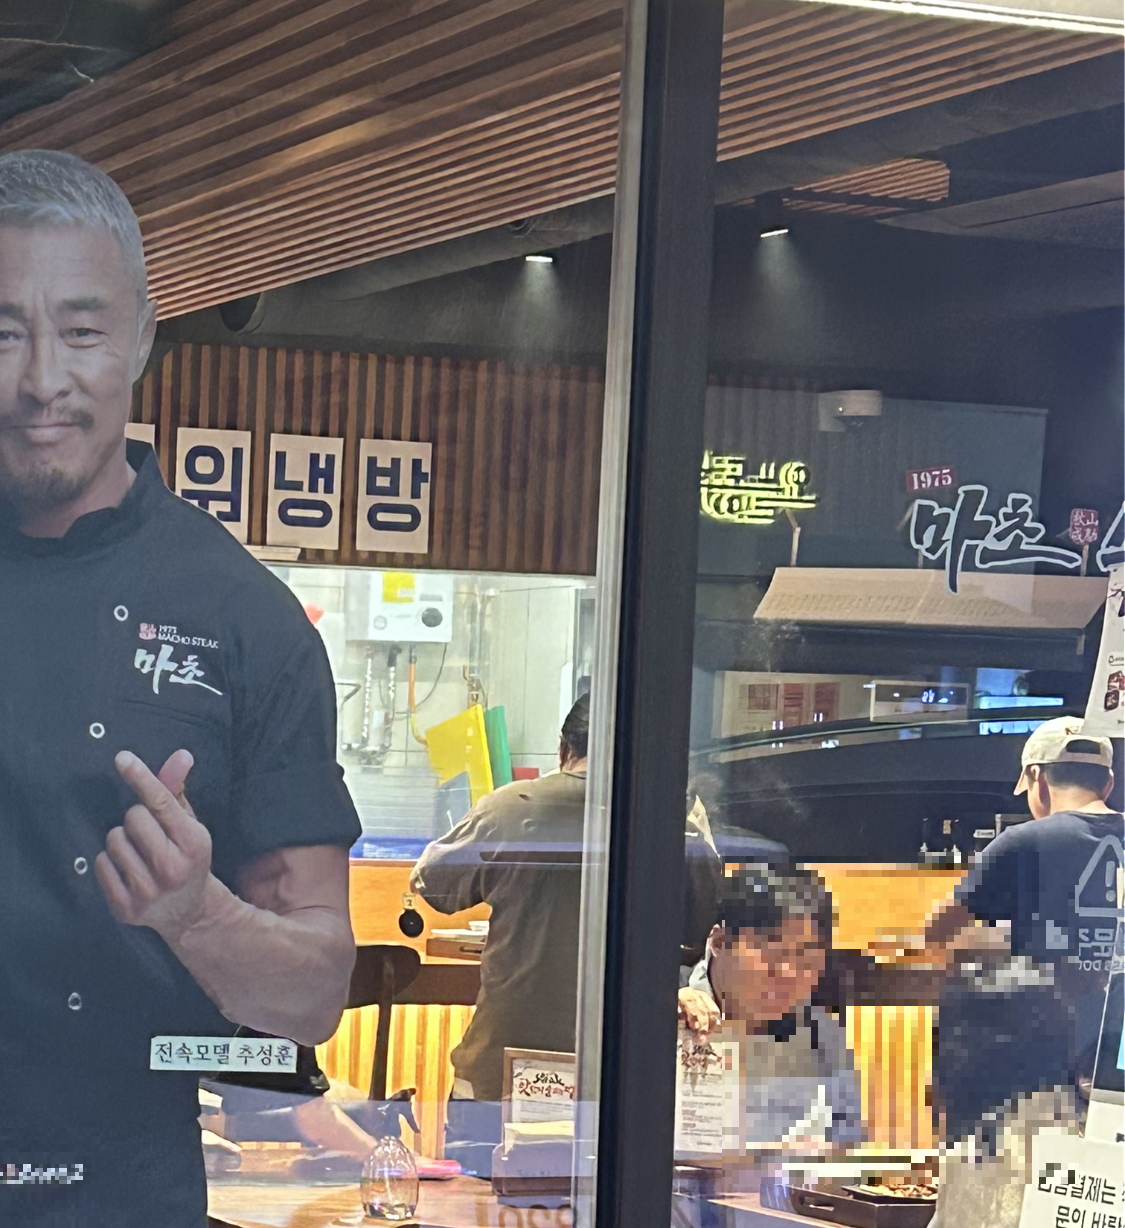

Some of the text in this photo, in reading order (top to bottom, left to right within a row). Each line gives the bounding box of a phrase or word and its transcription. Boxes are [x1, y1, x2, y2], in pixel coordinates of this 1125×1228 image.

[912, 468, 953, 490] 1975
[909, 484, 1082, 595] 마초
[158, 633, 219, 649] MACHO STEAK
[134, 644, 223, 695] 마초
[155, 1042, 293, 1066] 전속모델 추성훈
